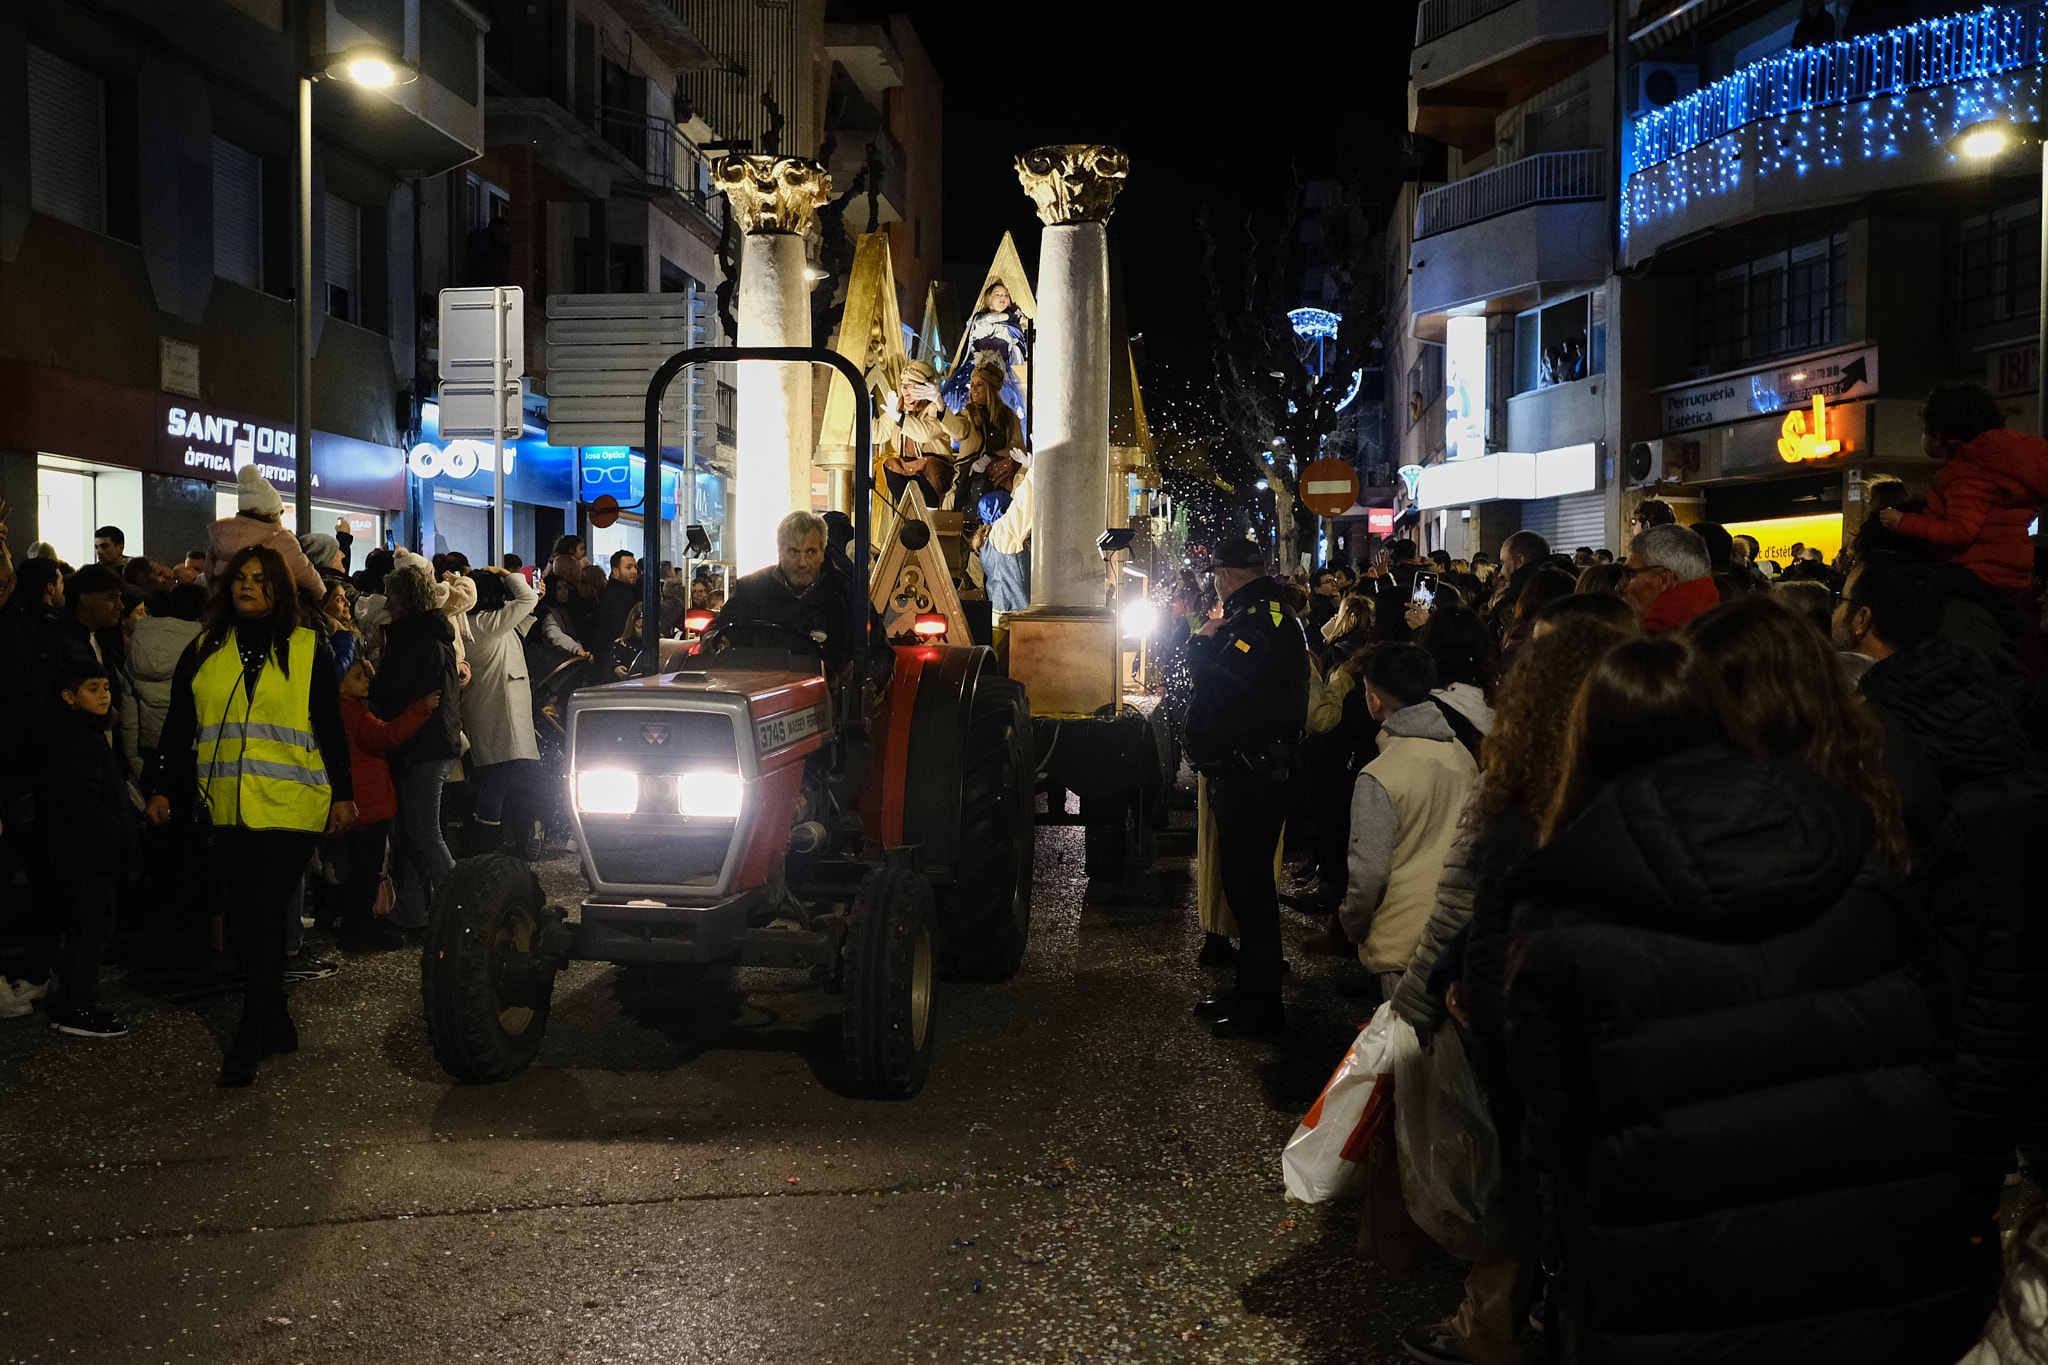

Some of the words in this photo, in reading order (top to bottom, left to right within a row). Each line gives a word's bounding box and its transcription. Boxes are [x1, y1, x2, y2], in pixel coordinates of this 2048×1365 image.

[1667, 385, 1735, 411] Perruqueria
[166, 407, 239, 446] SANT
[1668, 410, 1713, 430] Estètica
[585, 452, 601, 460] Josa
[602, 451, 626, 460] Optics
[184, 445, 232, 472] ÒPTICA
[255, 463, 320, 487] ORTOPA
[1764, 545, 1792, 559] d'Estèt
[787, 716, 806, 735] MASSEY
